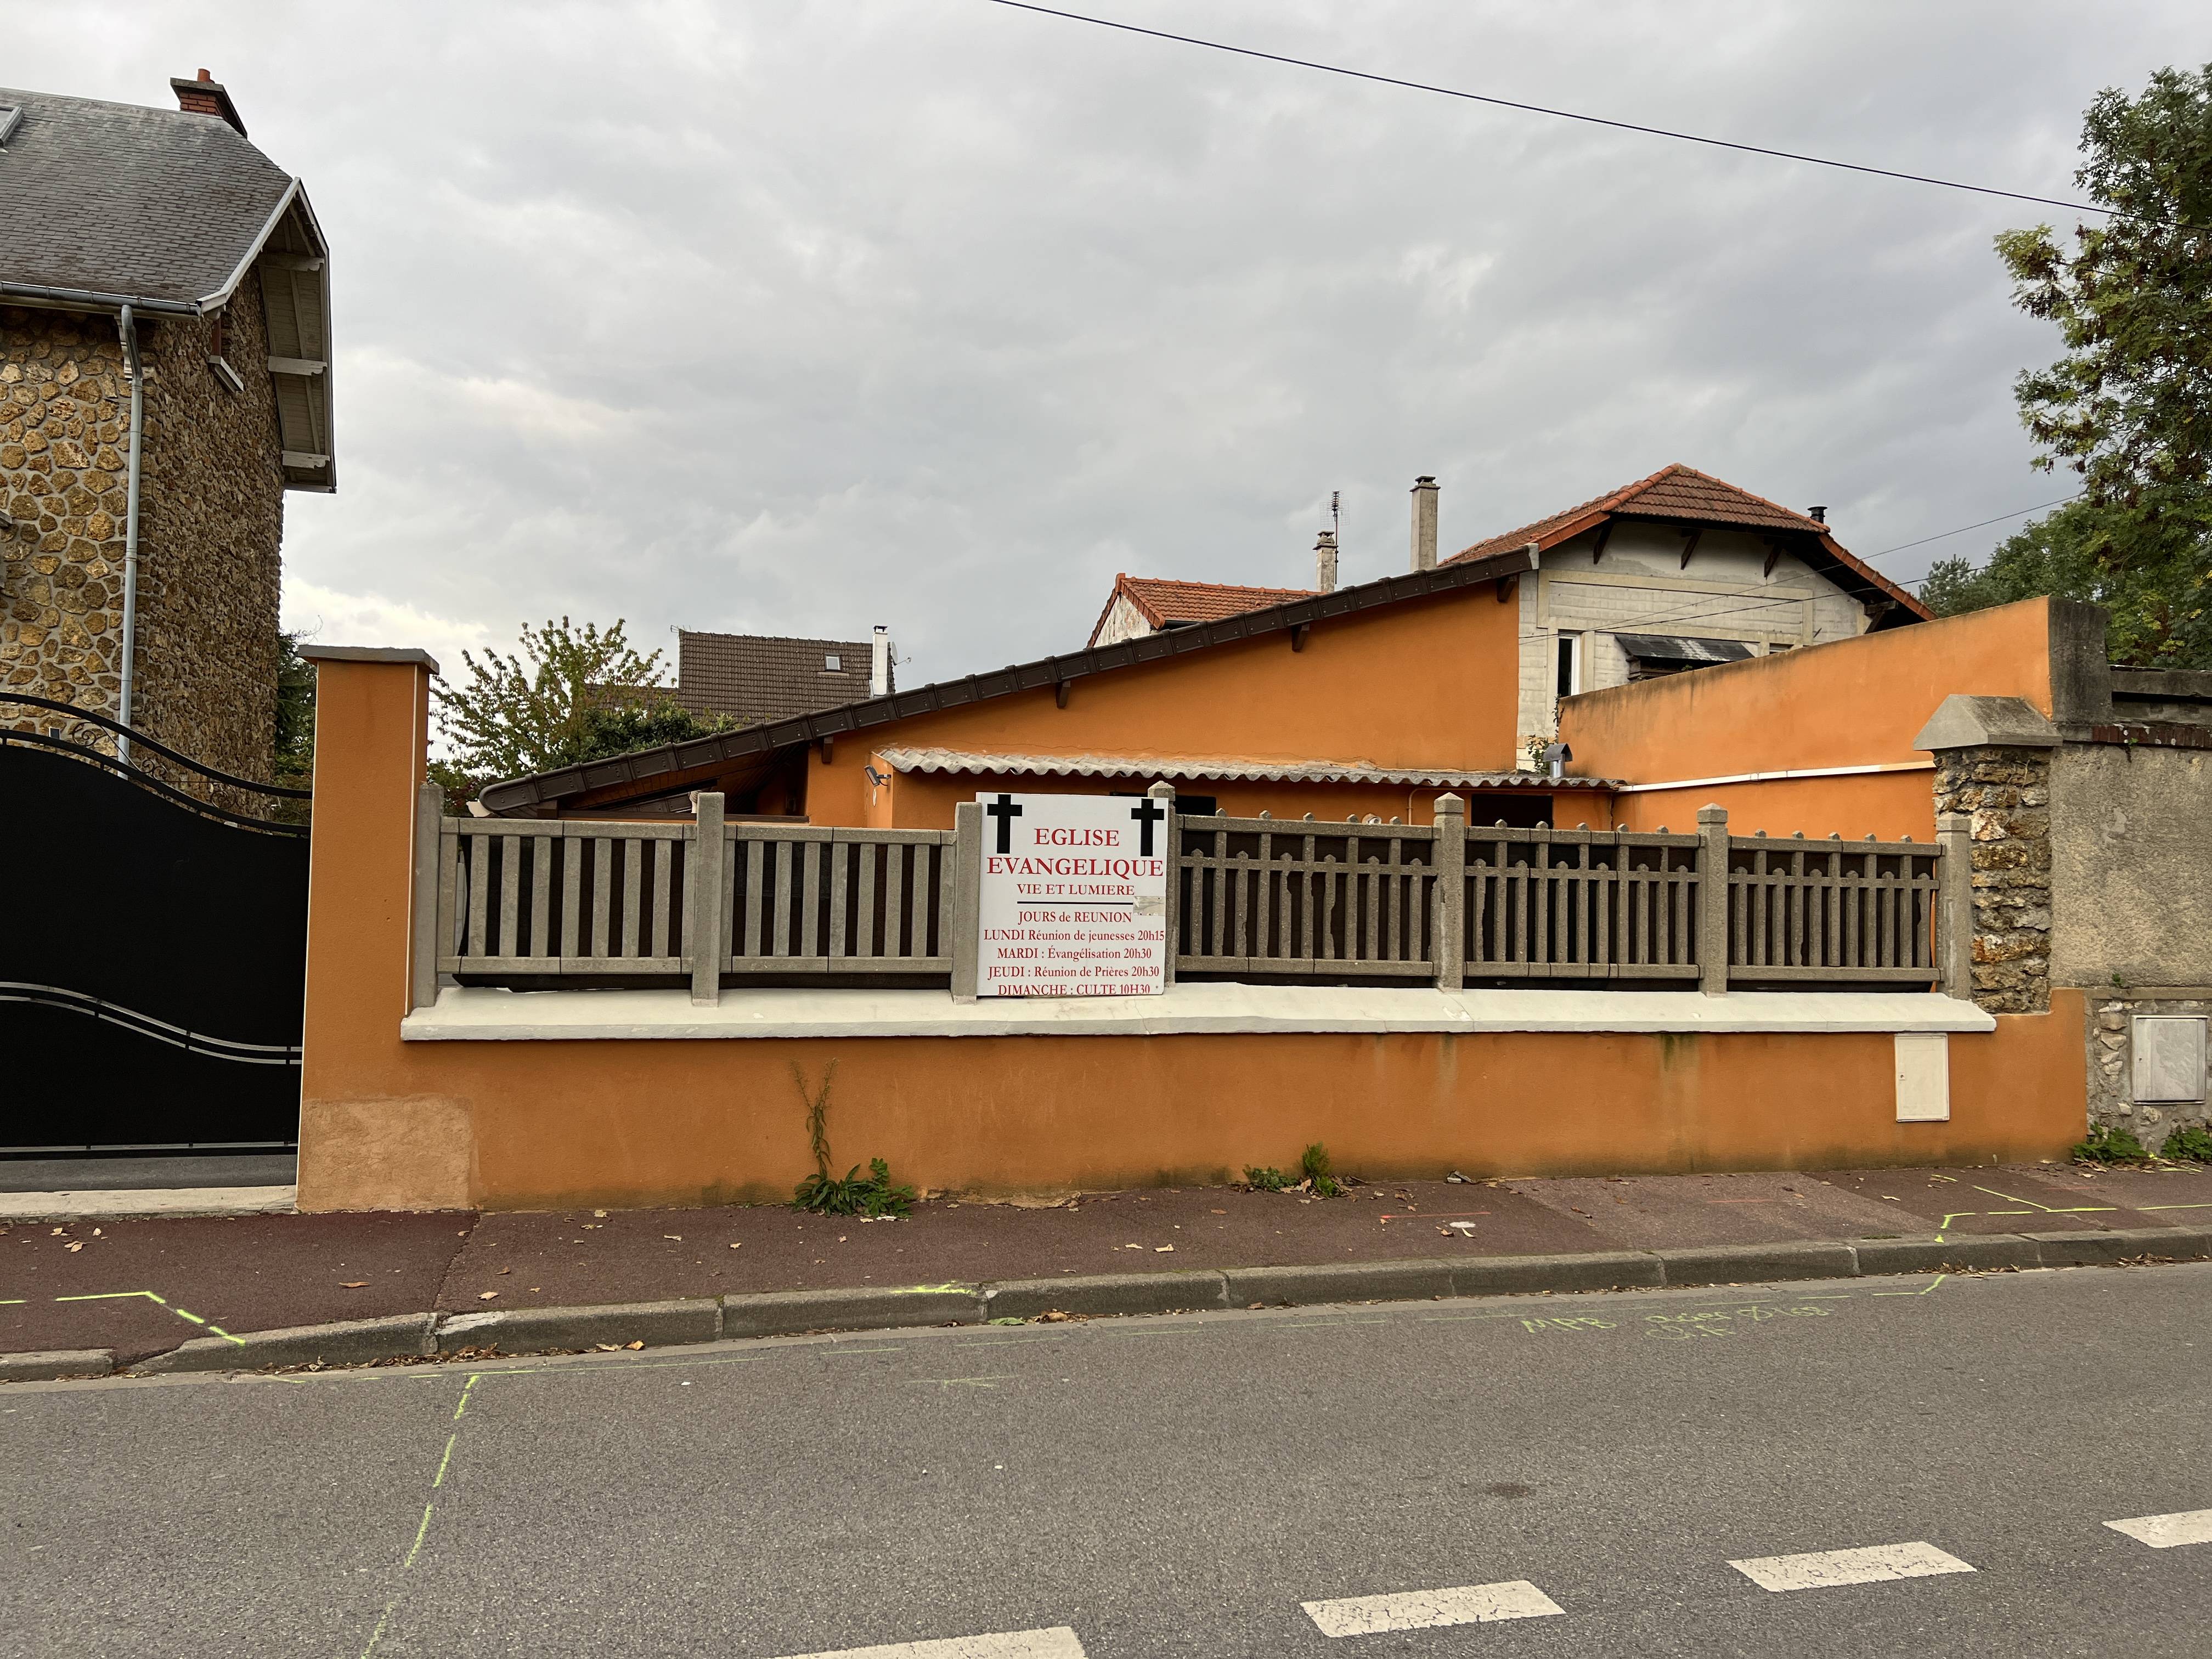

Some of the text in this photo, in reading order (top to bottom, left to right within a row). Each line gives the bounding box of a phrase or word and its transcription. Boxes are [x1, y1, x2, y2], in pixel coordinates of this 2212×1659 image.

[1034, 828, 1120, 847] EGLISE
[986, 857, 1164, 879] EVANGELIQUE
[1017, 883, 1135, 895] VIE ET LUMIERE
[1018, 911, 1132, 925] JOURS de REUNION
[984, 928, 1164, 943] LUNDI Réunion de jeunesses 20h15
[997, 947, 1039, 959] MARDI
[1048, 945, 1121, 962] Évangélisation
[1124, 947, 1152, 959] 20h30
[988, 966, 1025, 981] JEUDI
[1033, 966, 1077, 978] Réunion
[1079, 966, 1091, 978] de
[1094, 966, 1130, 978] Prières
[1132, 966, 1161, 977] 20h30
[998, 984, 1067, 995] DIMANCHE
[1076, 984, 1116, 995] CULTE
[1119, 985, 1150, 995] 10H30
